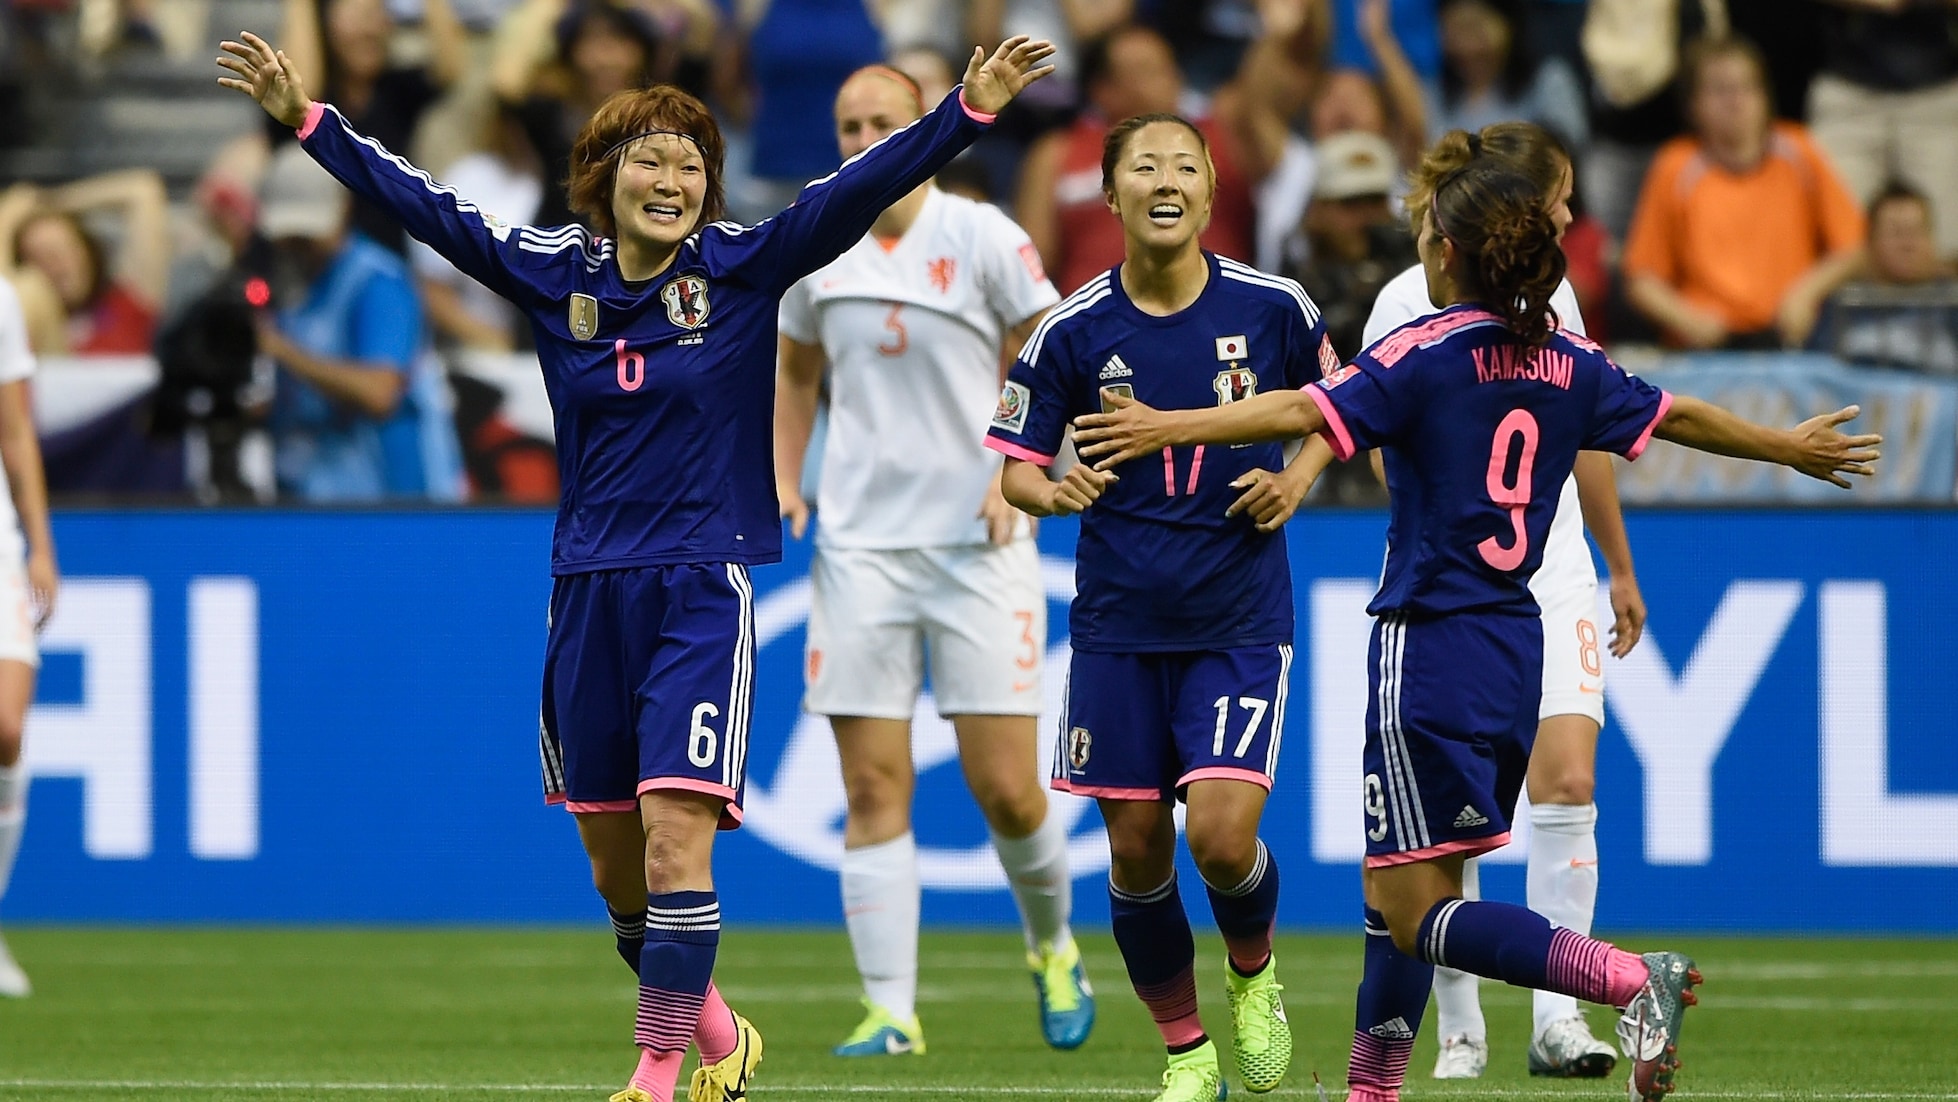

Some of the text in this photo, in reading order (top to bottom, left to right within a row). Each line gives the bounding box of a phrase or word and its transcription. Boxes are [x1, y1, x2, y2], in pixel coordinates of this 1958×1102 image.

[878, 301, 909, 357] 3
[615, 339, 645, 392] 6
[1099, 368, 1133, 380] adidas
[1471, 345, 1574, 390] KAWASUMI
[1477, 409, 1539, 571] 9
[1013, 610, 1039, 670] 3
[1576, 619, 1601, 677] 8
[687, 702, 720, 768] 6
[1213, 695, 1269, 759] 17
[1364, 773, 1388, 842] 9
